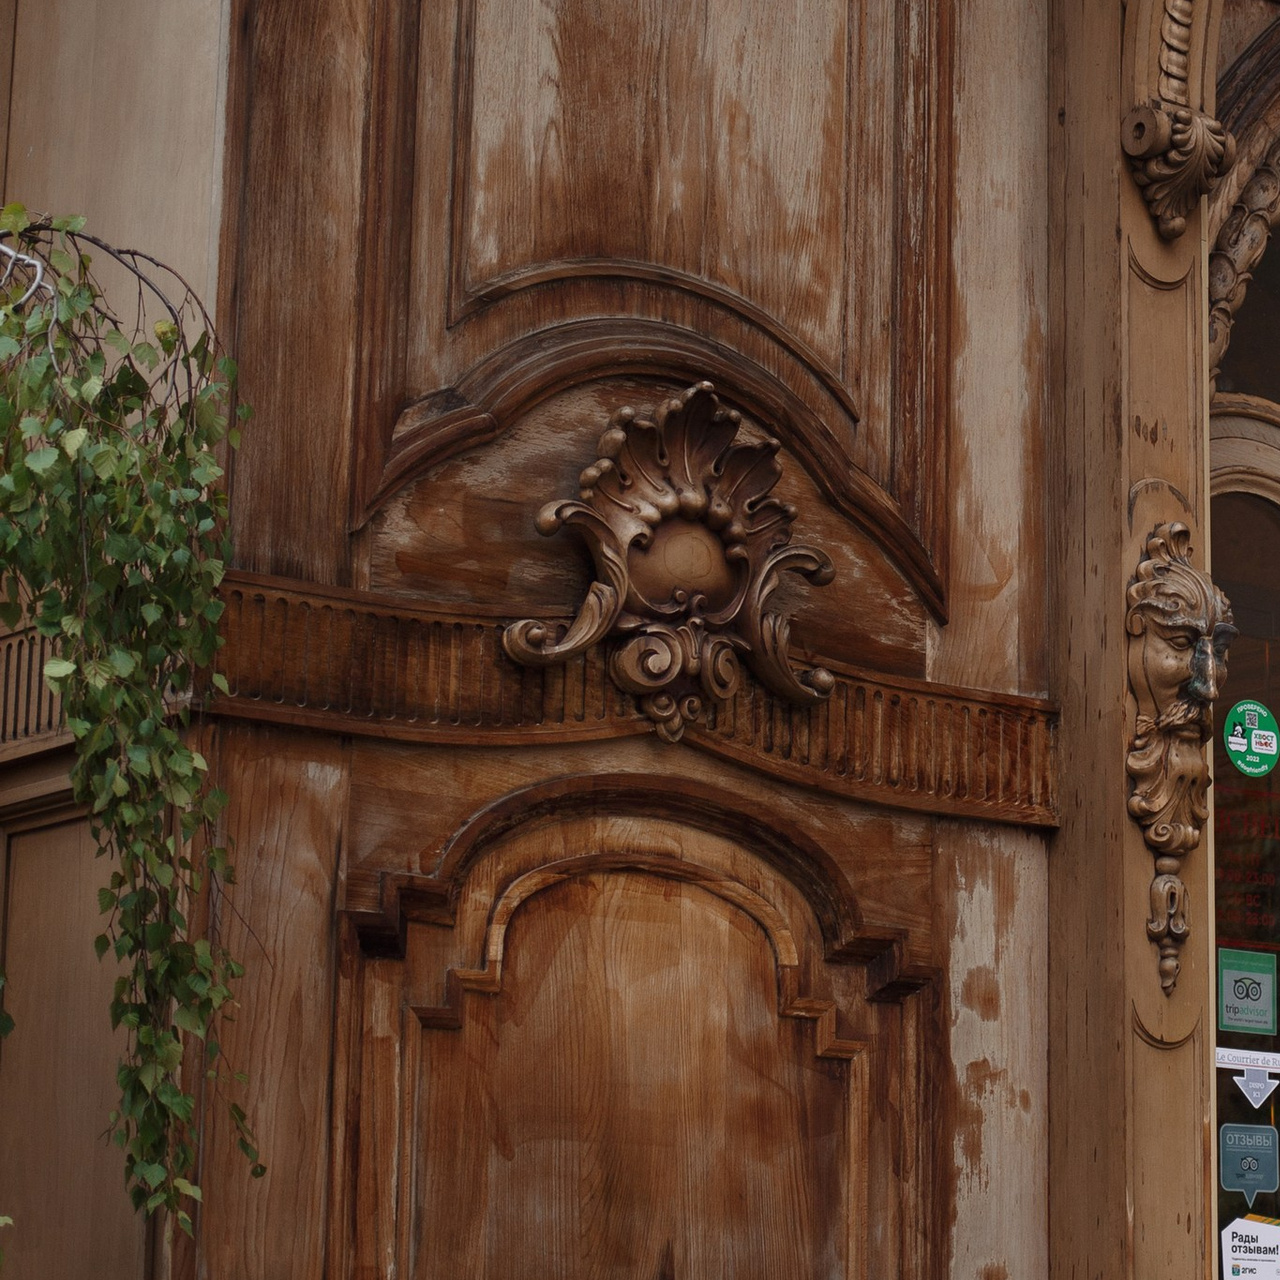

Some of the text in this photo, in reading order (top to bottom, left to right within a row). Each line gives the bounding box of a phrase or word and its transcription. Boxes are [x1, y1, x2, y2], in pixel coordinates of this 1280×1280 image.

[1225, 1003, 1268, 1017] tripadvisor
[1216, 1052, 1226, 1061] Le
[1227, 1053, 1259, 1066] Courrier
[1260, 1056, 1271, 1066] de
[1226, 1133, 1273, 1147] ОТЗЫВЫ
[1231, 1231, 1259, 1245] Рады
[1231, 1244, 1280, 1256] отзывам!
